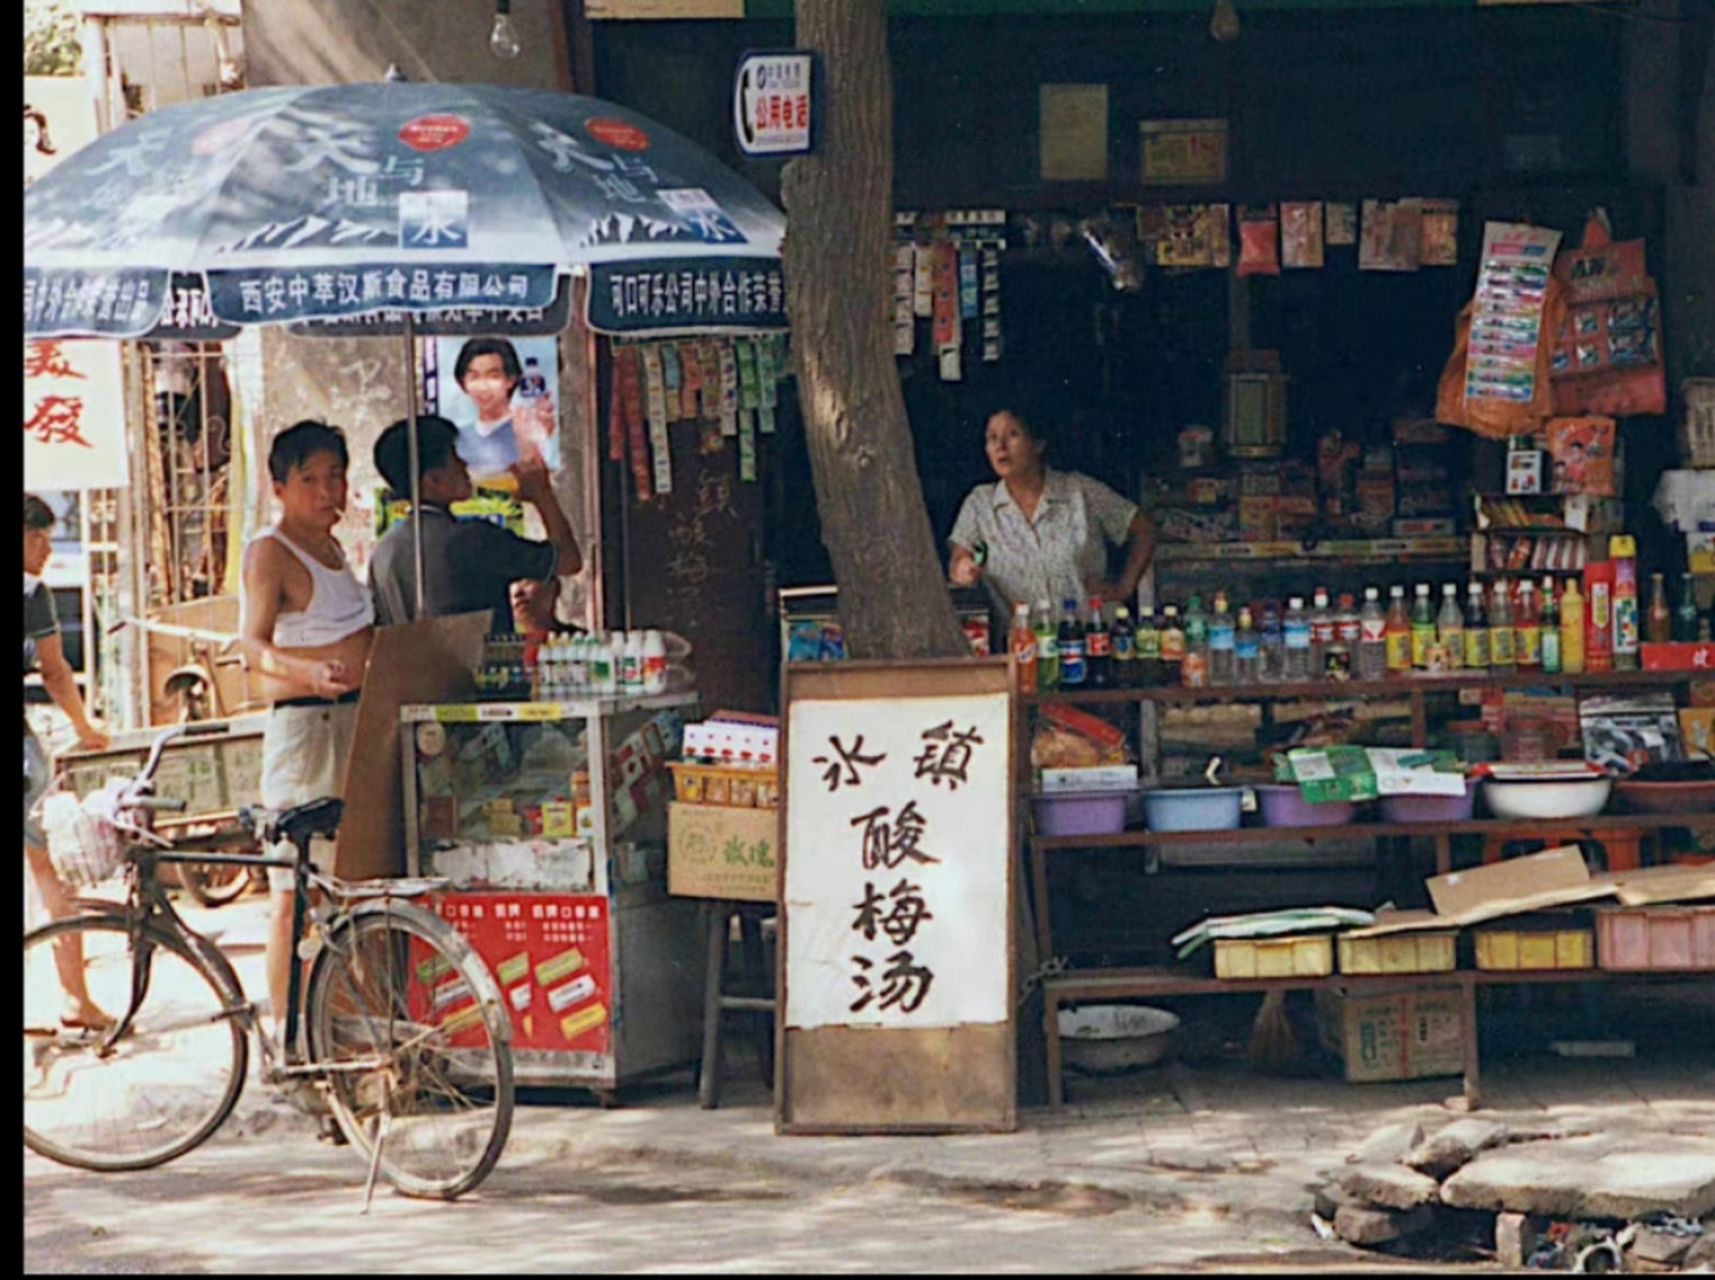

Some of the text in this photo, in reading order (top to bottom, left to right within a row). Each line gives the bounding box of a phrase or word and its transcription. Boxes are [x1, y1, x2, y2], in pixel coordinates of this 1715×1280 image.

[756, 95, 807, 130] 公用电话
[609, 271, 788, 317] 可口可乐公司中外合作荣誉
[850, 799, 942, 1014] 酸梅汤
